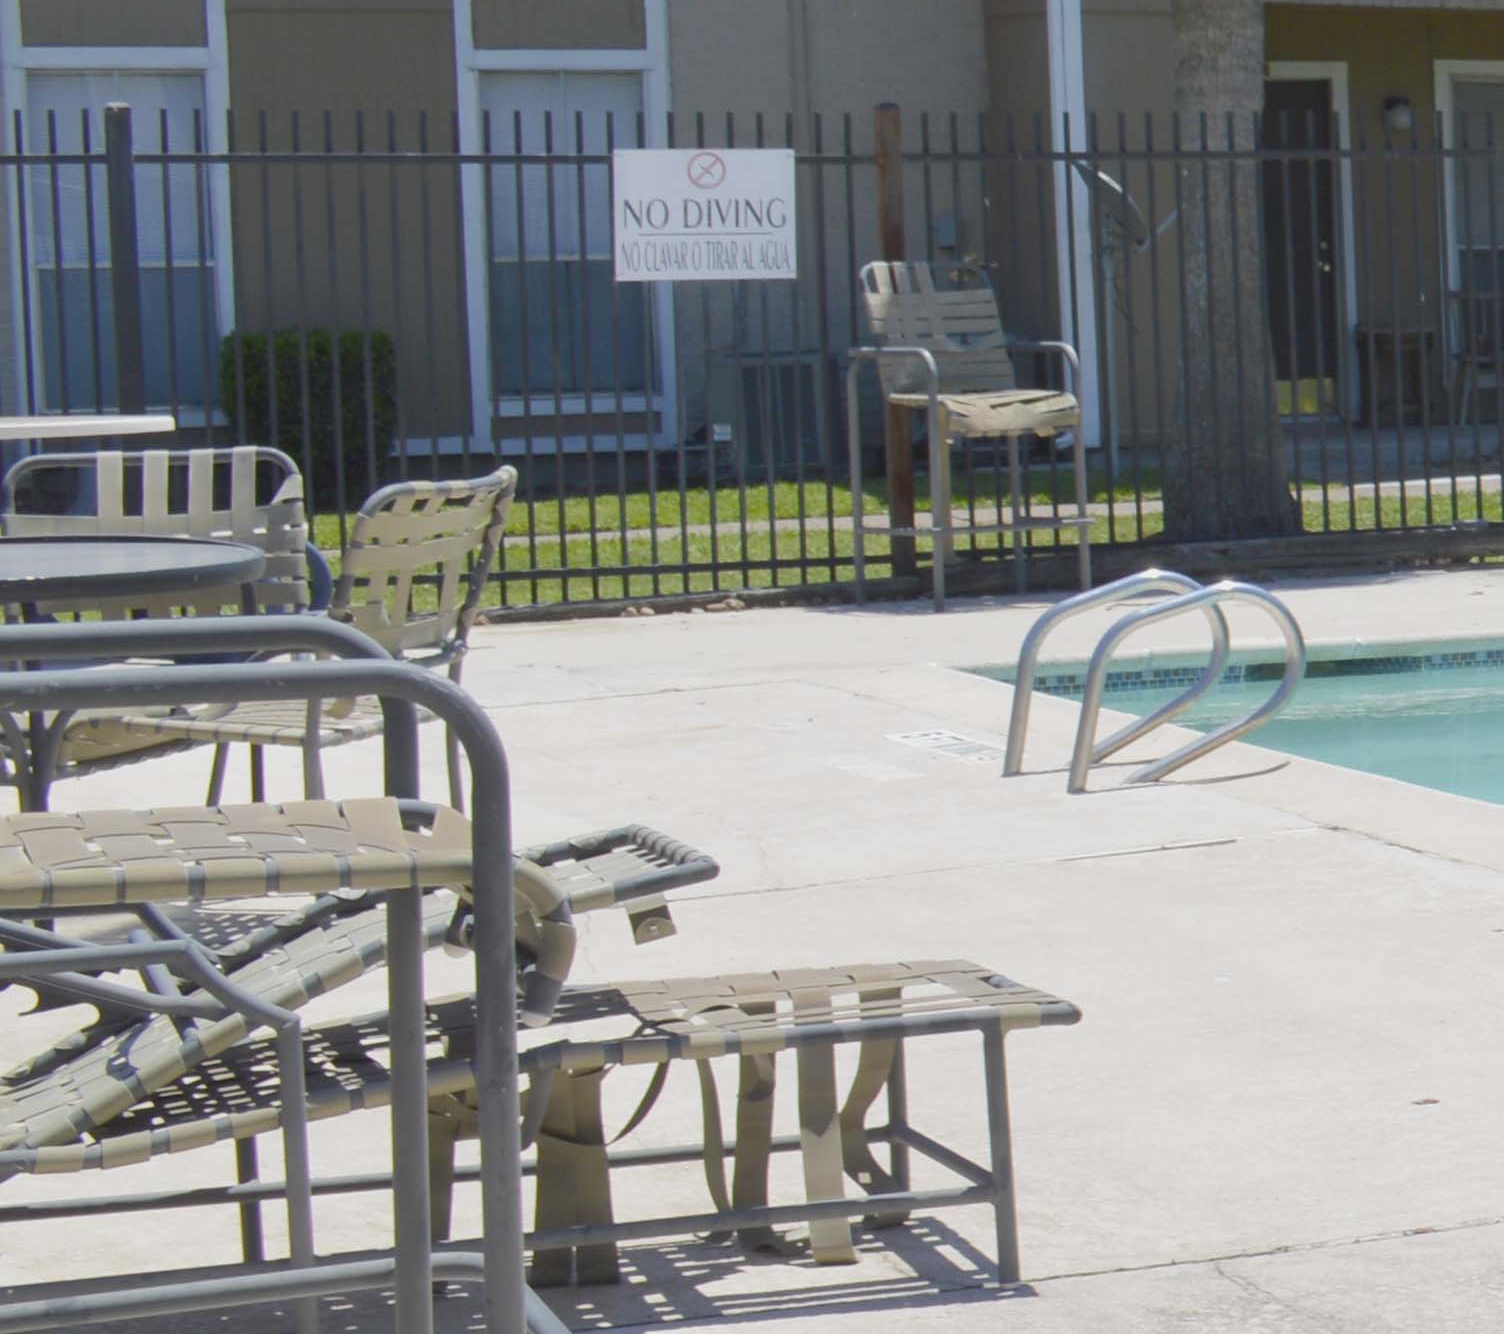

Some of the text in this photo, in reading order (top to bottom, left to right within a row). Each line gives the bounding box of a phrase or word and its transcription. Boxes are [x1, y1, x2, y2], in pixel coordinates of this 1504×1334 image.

[623, 197, 788, 230] NO DIVING
[621, 240, 792, 272] NO CLAVAR O TIRAR AL AGUA
